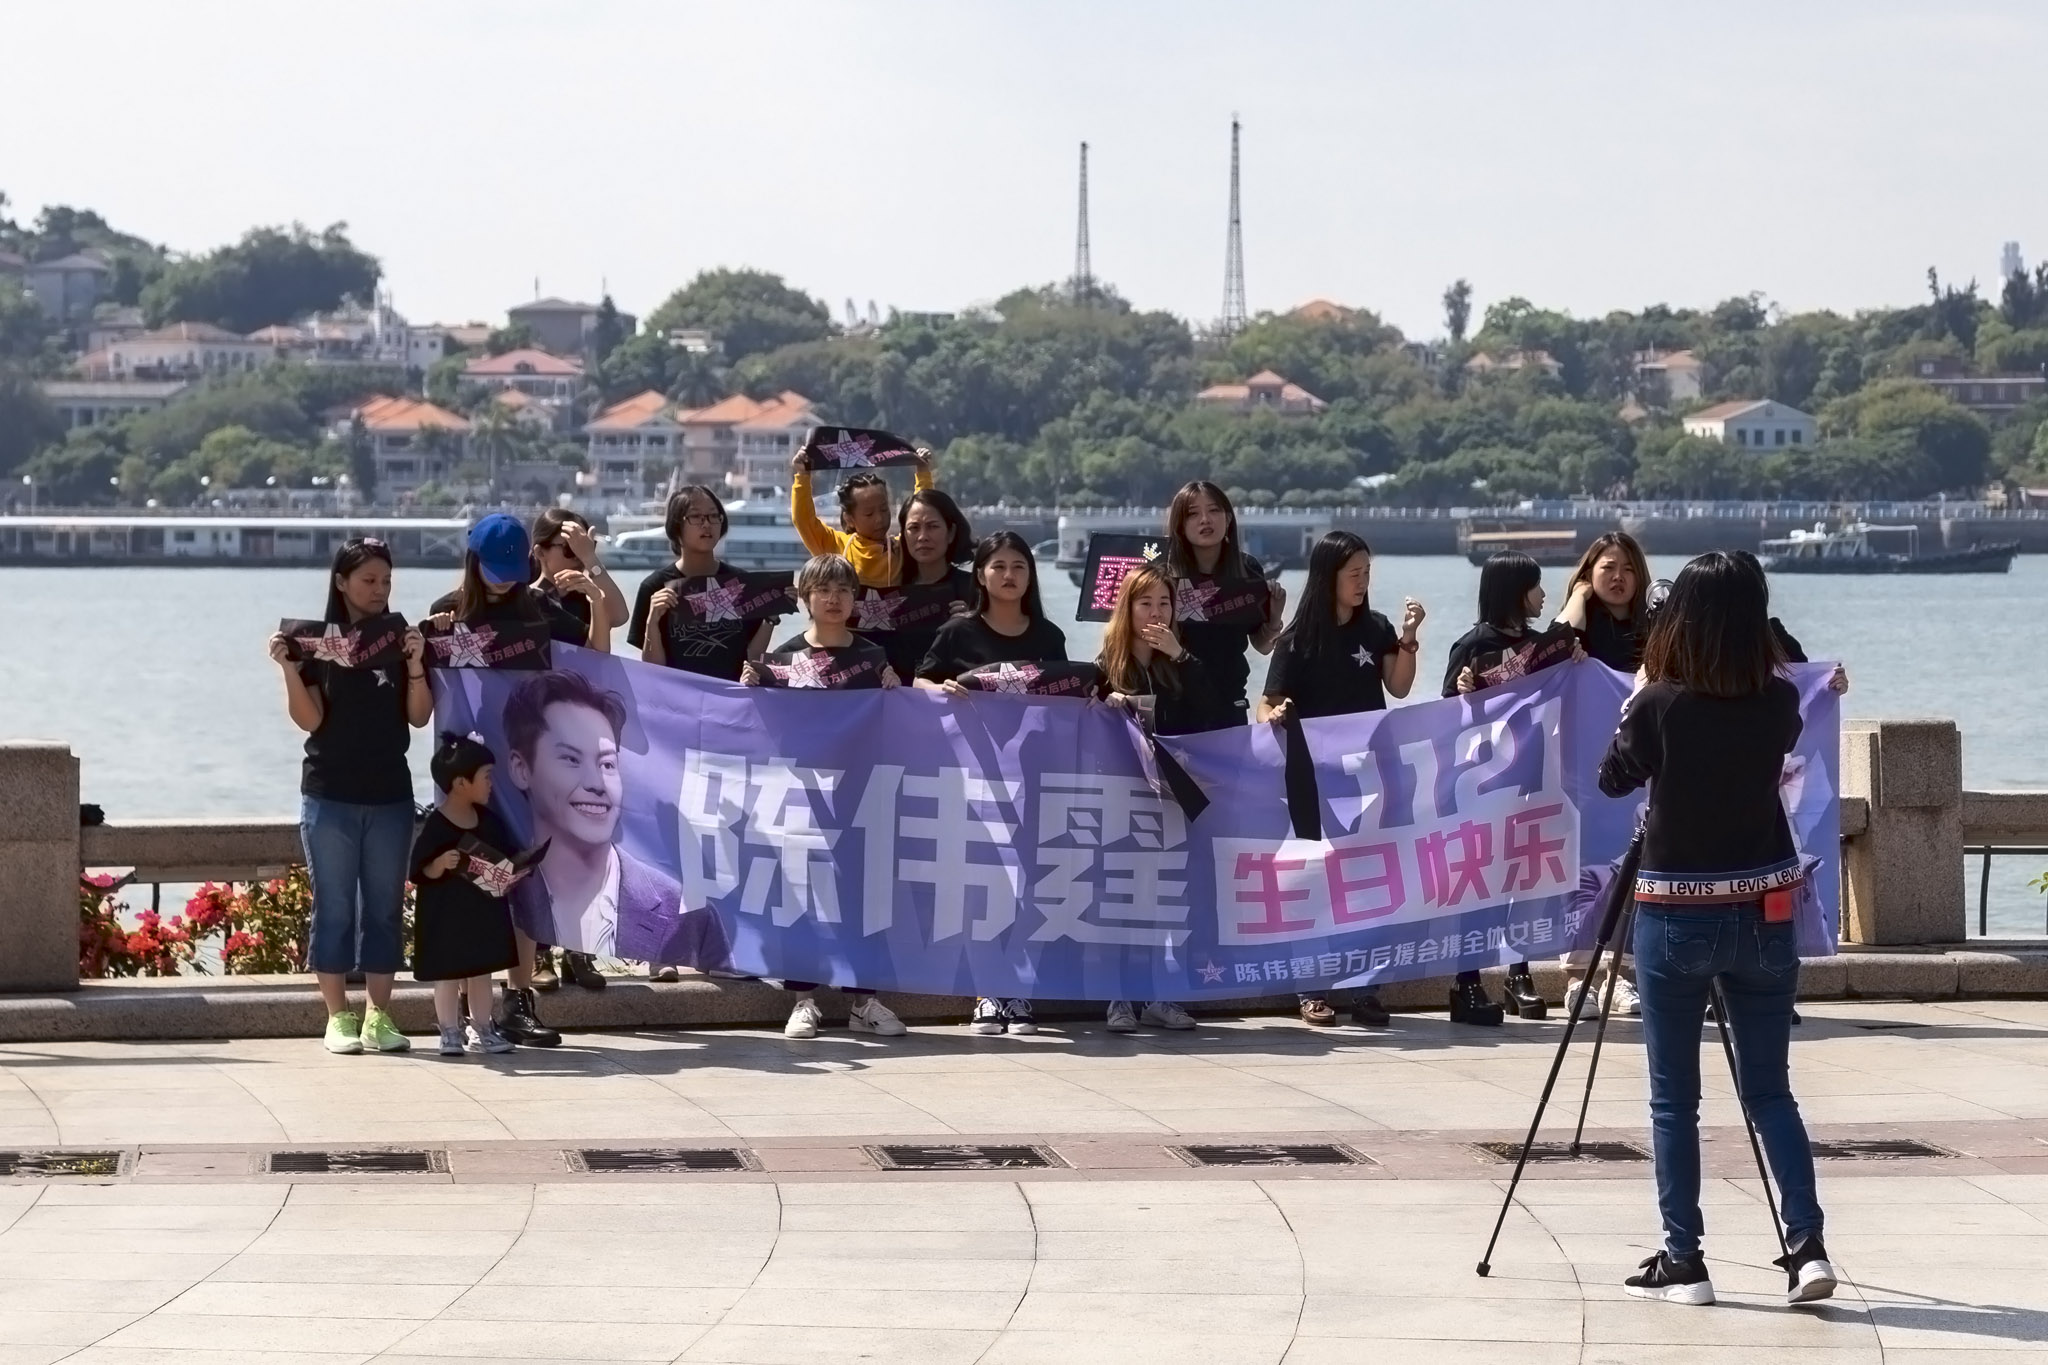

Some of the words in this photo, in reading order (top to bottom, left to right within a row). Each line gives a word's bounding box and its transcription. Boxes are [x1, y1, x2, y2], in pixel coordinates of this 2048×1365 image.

[678, 747, 1193, 948] 陈伟霆
[1232, 802, 1567, 935] 生日快乐
[1234, 917, 1554, 984] 陈伟霆官方后援会携全体女皇
[1563, 910, 1581, 938] 贺
